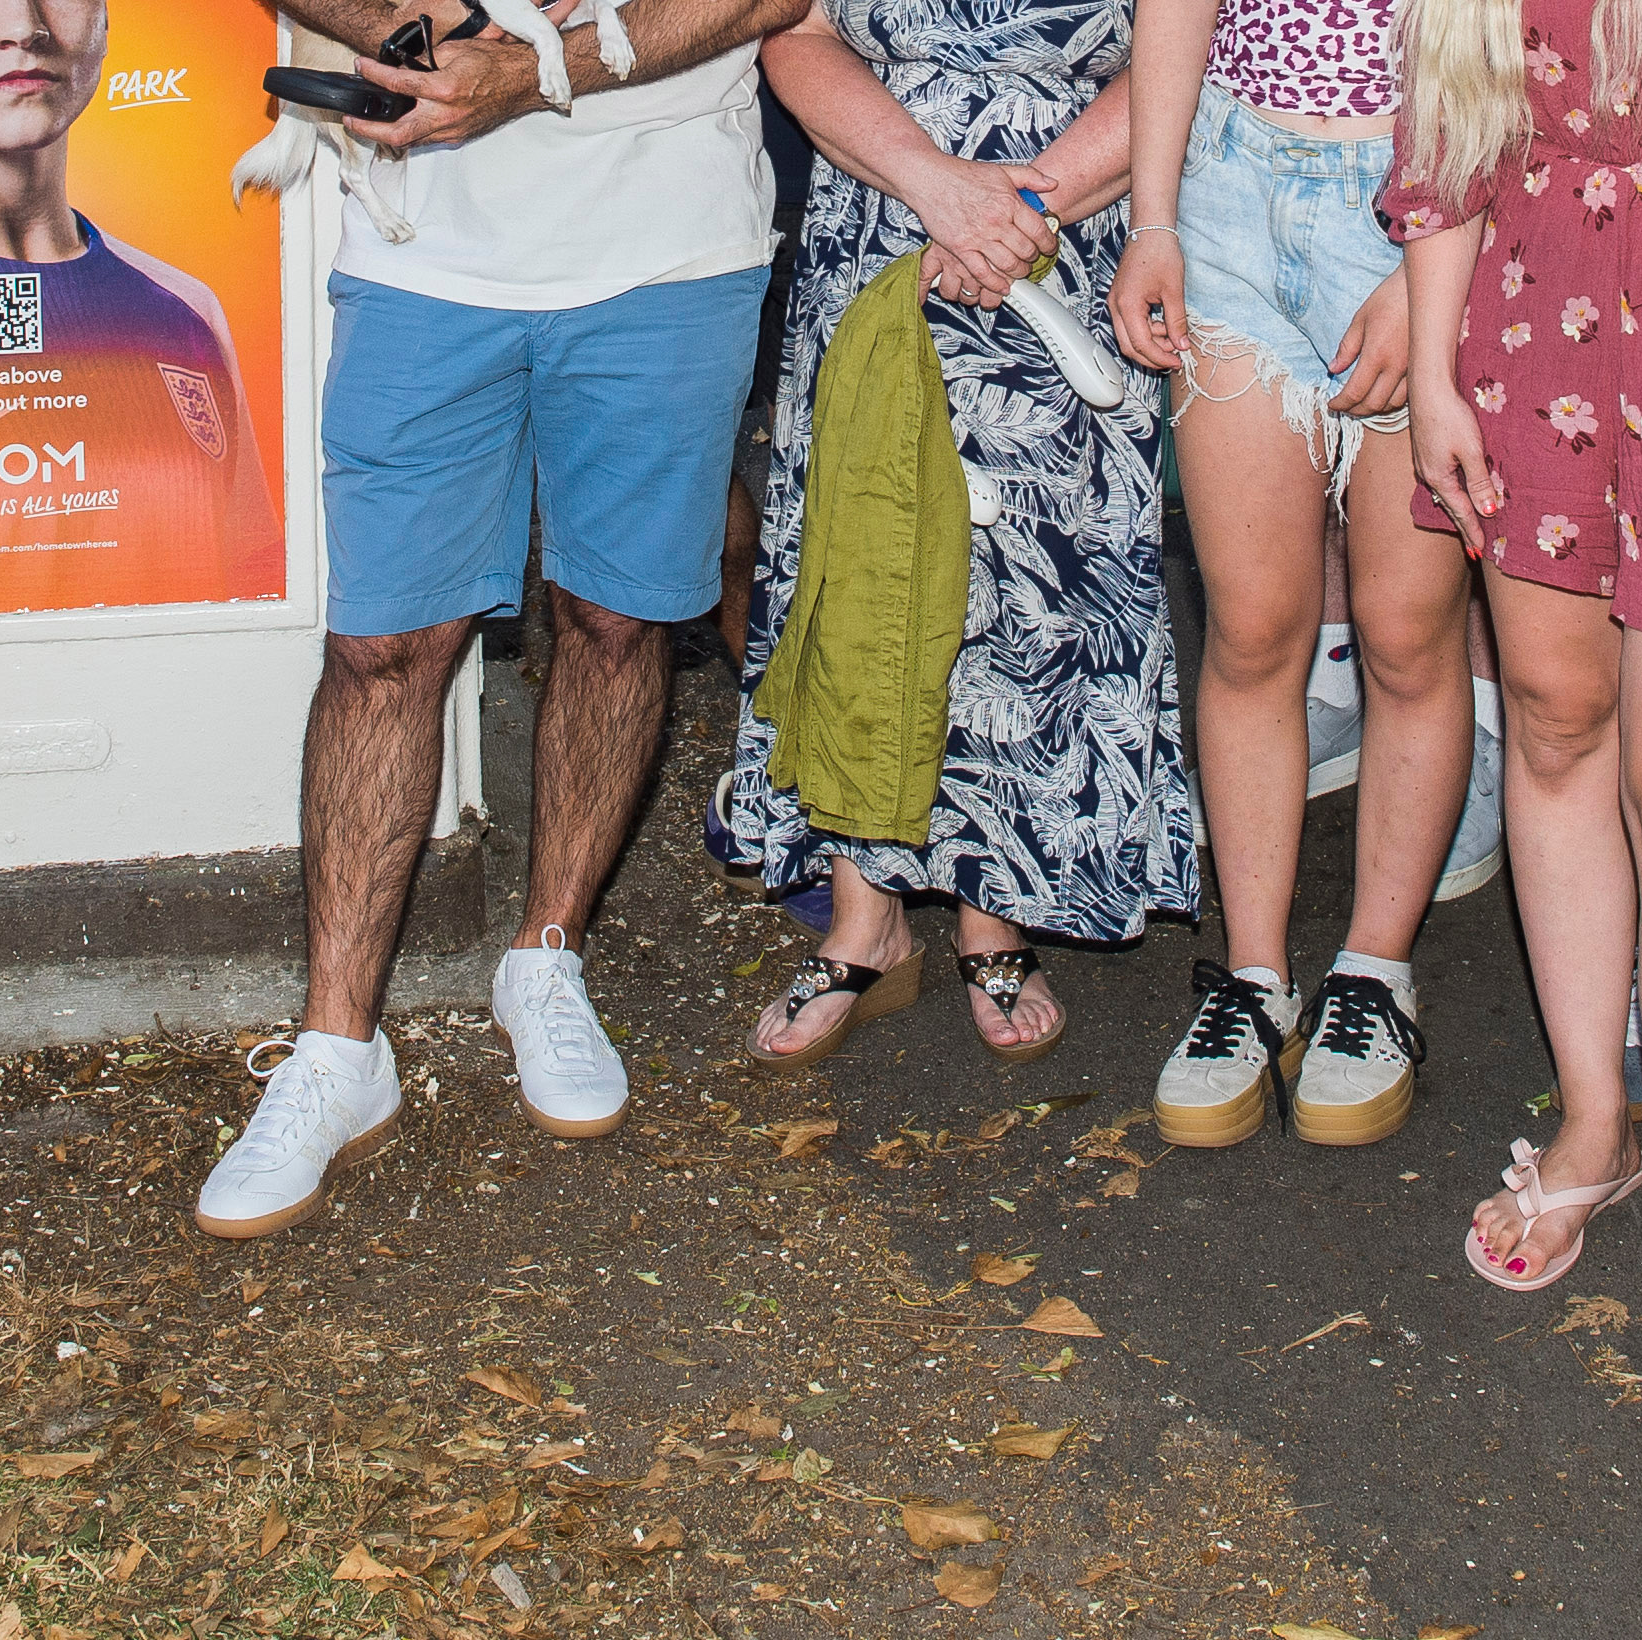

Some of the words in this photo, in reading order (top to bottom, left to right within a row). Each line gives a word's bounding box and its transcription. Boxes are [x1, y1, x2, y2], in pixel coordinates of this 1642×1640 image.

[107, 67, 188, 101] PARK
[33, 393, 88, 410] more
[0, 498, 18, 515] IS
[21, 495, 56, 514] ALL
[61, 488, 120, 515] YOURS
